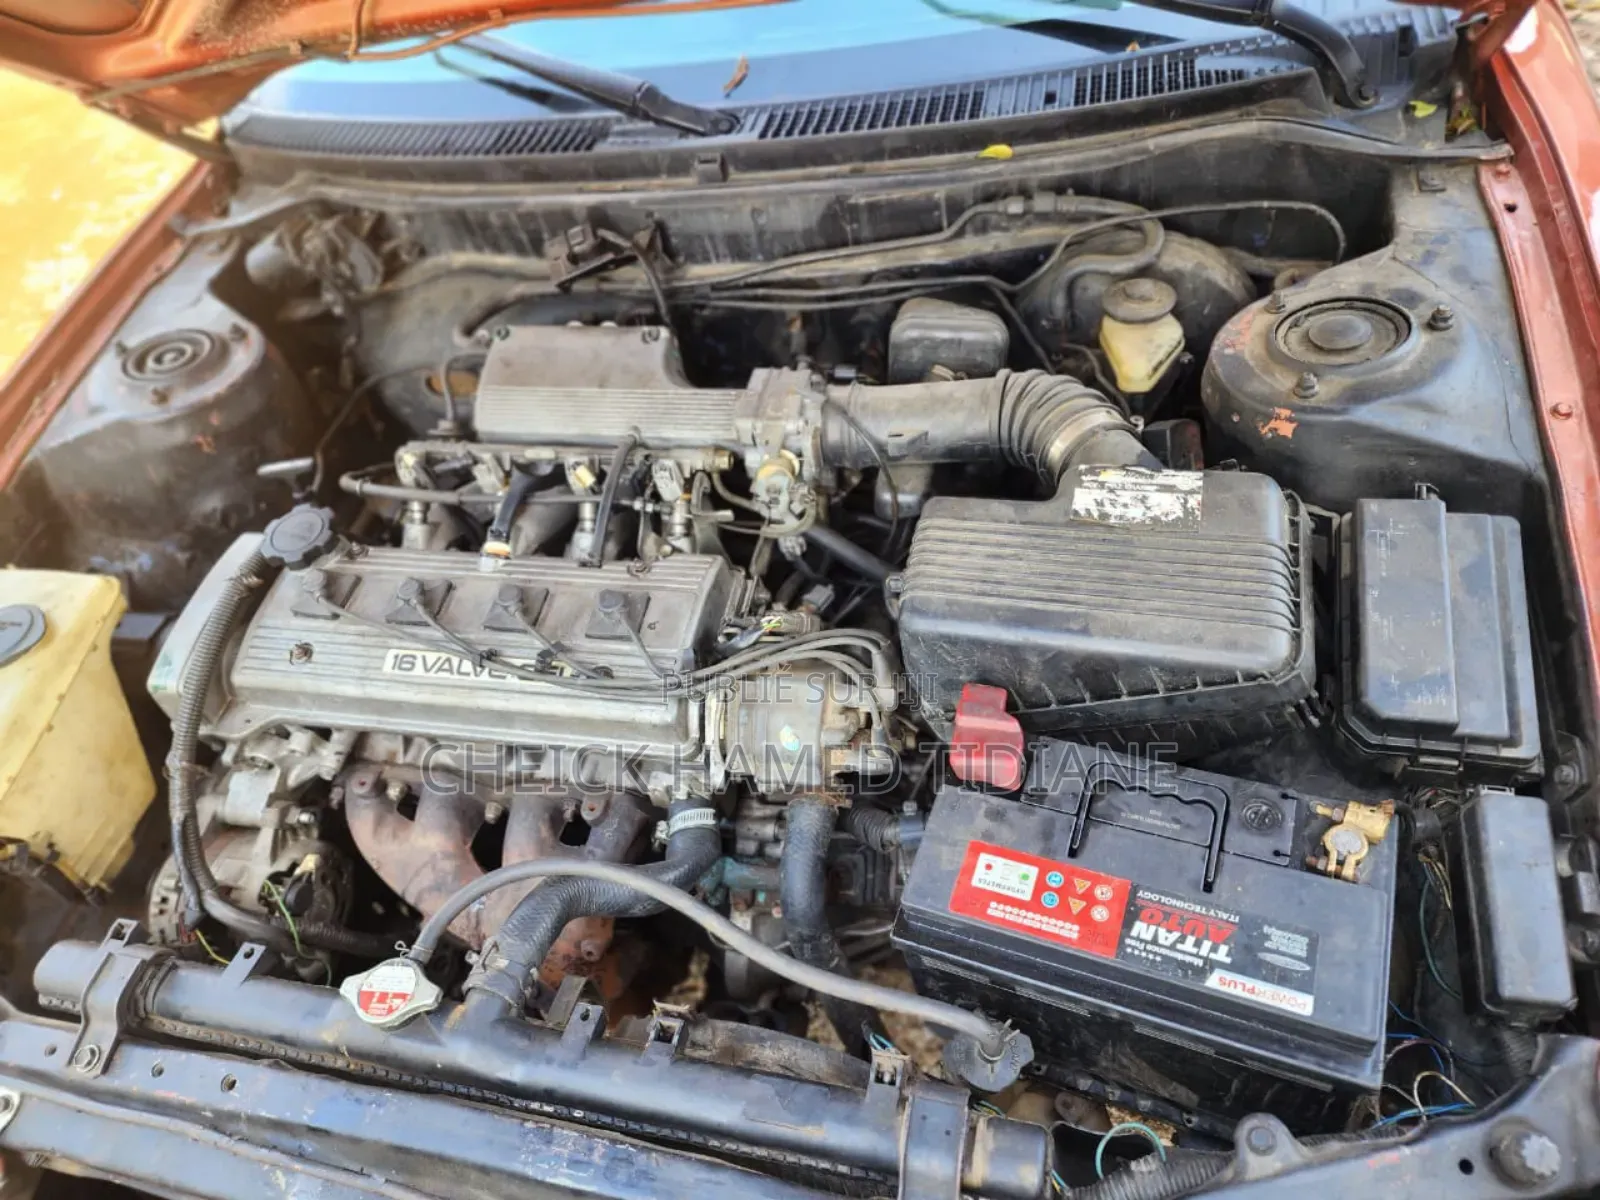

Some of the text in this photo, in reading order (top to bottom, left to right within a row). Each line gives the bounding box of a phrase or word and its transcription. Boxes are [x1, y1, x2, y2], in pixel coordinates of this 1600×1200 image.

[391, 653, 417, 672] 16
[1136, 890, 1240, 923] ITALY TECHNOLOGY
[1129, 920, 1232, 965] TITAN
[1140, 908, 1236, 944] AUTO
[1124, 938, 1204, 968] Maintenance Free
